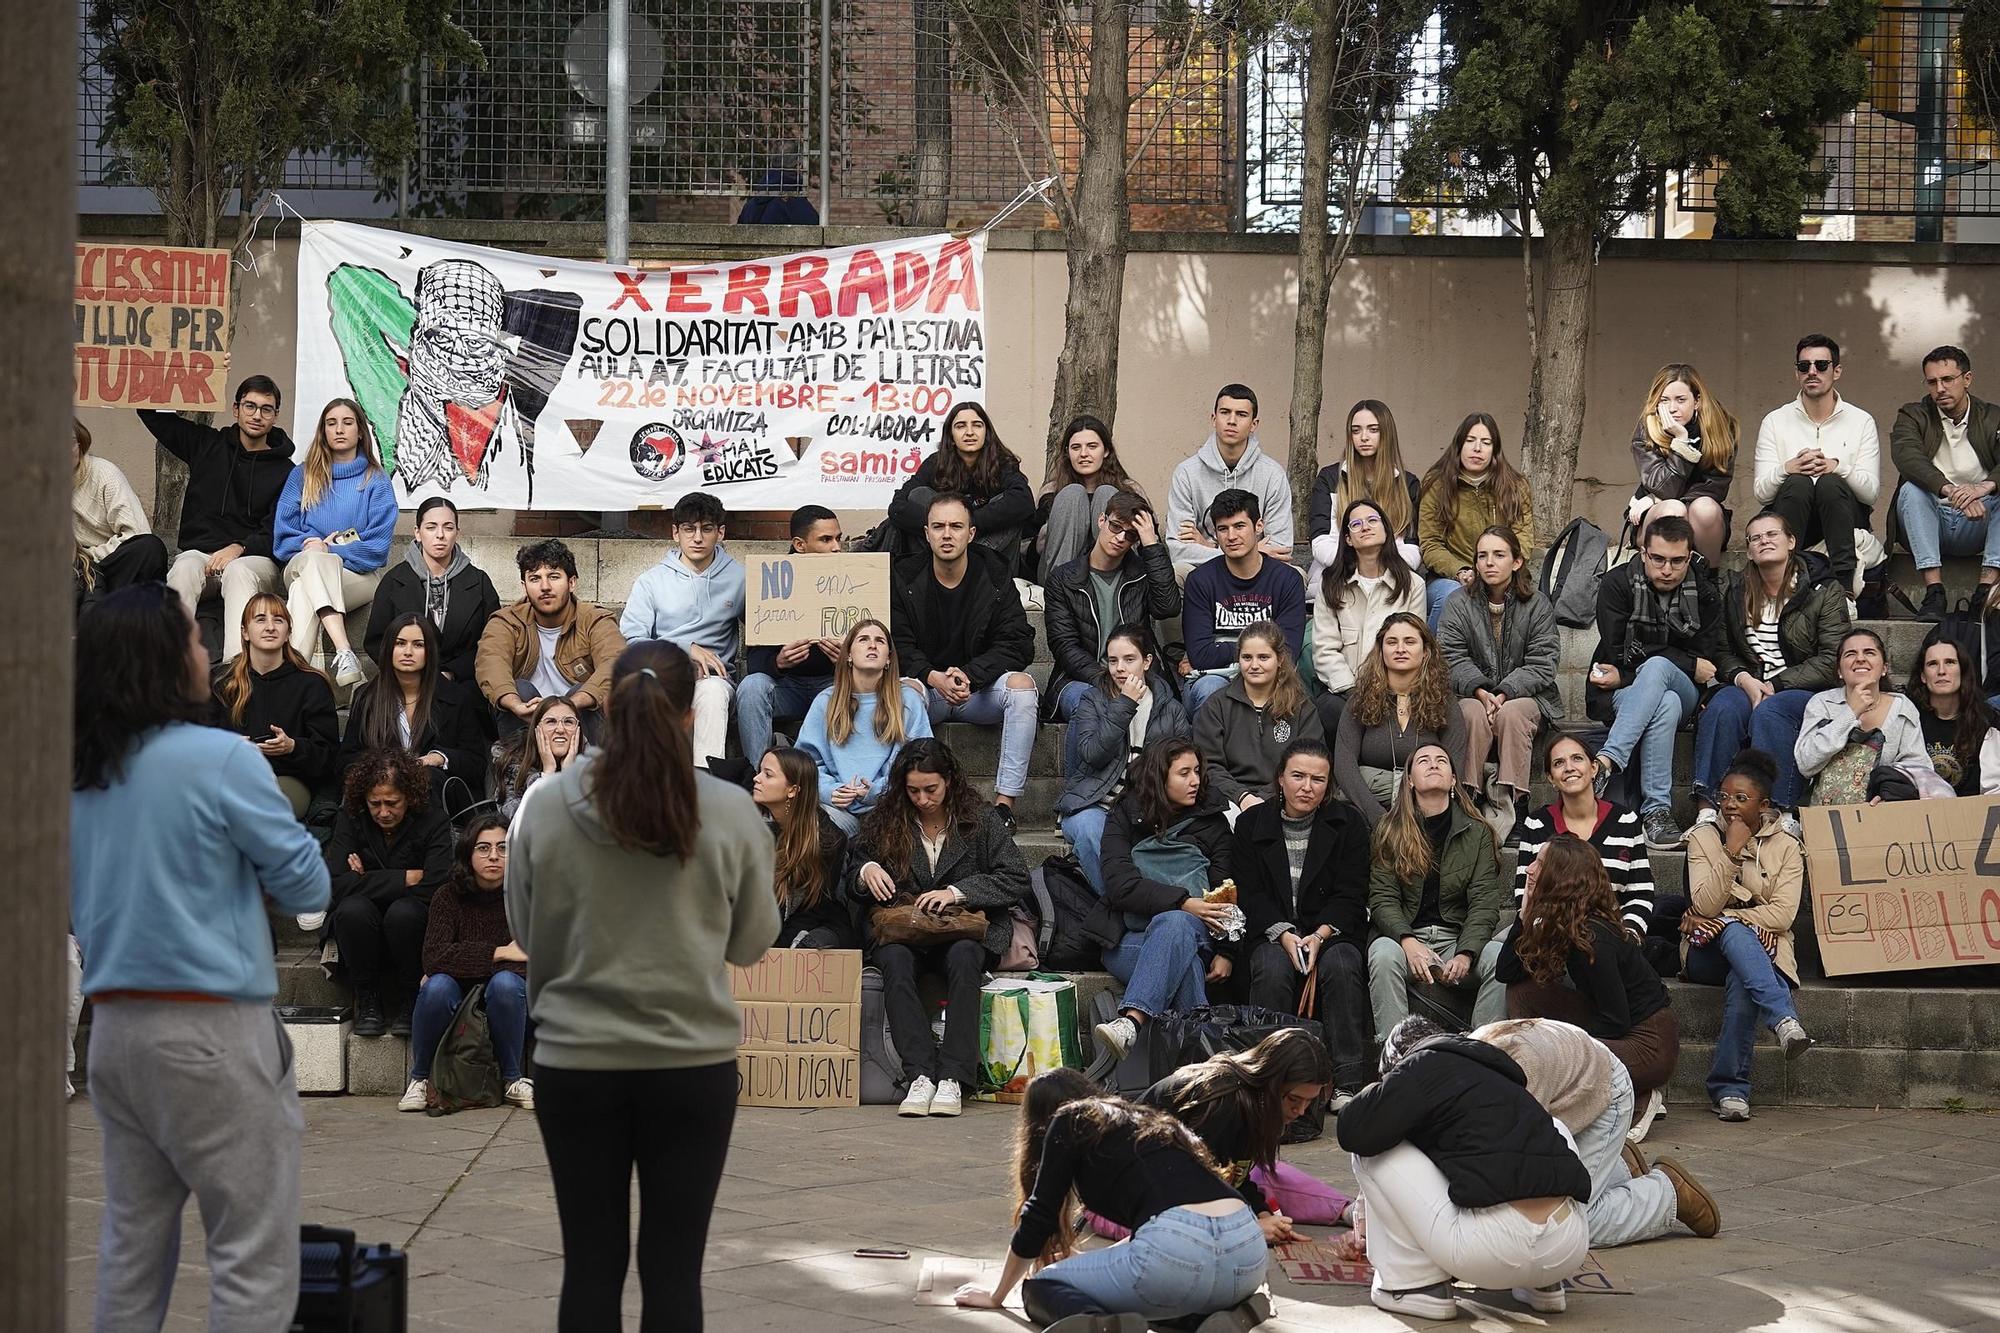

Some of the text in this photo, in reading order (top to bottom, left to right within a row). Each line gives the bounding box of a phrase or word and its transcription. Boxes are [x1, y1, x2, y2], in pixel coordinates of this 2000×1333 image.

[606, 238, 980, 318] XERRADA
[93, 305, 154, 347] LLOC
[171, 306, 224, 352] PER
[580, 316, 984, 357] SOLIDARITAT AMB PALESTINA
[73, 346, 217, 404] TUDIAR
[577, 353, 644, 380] AULA
[702, 353, 827, 385] FACULTAT
[832, 351, 867, 382] DE
[878, 351, 985, 389] LLETRES
[677, 380, 839, 413] NOVEMBRE
[862, 381, 953, 416] 13:00
[703, 454, 779, 482] EDUCATS
[722, 437, 771, 460] MAL
[761, 560, 870, 600] NO ens
[1828, 895, 1868, 936] és
[794, 952, 852, 994] DRET
[787, 1006, 841, 1045] LLOC
